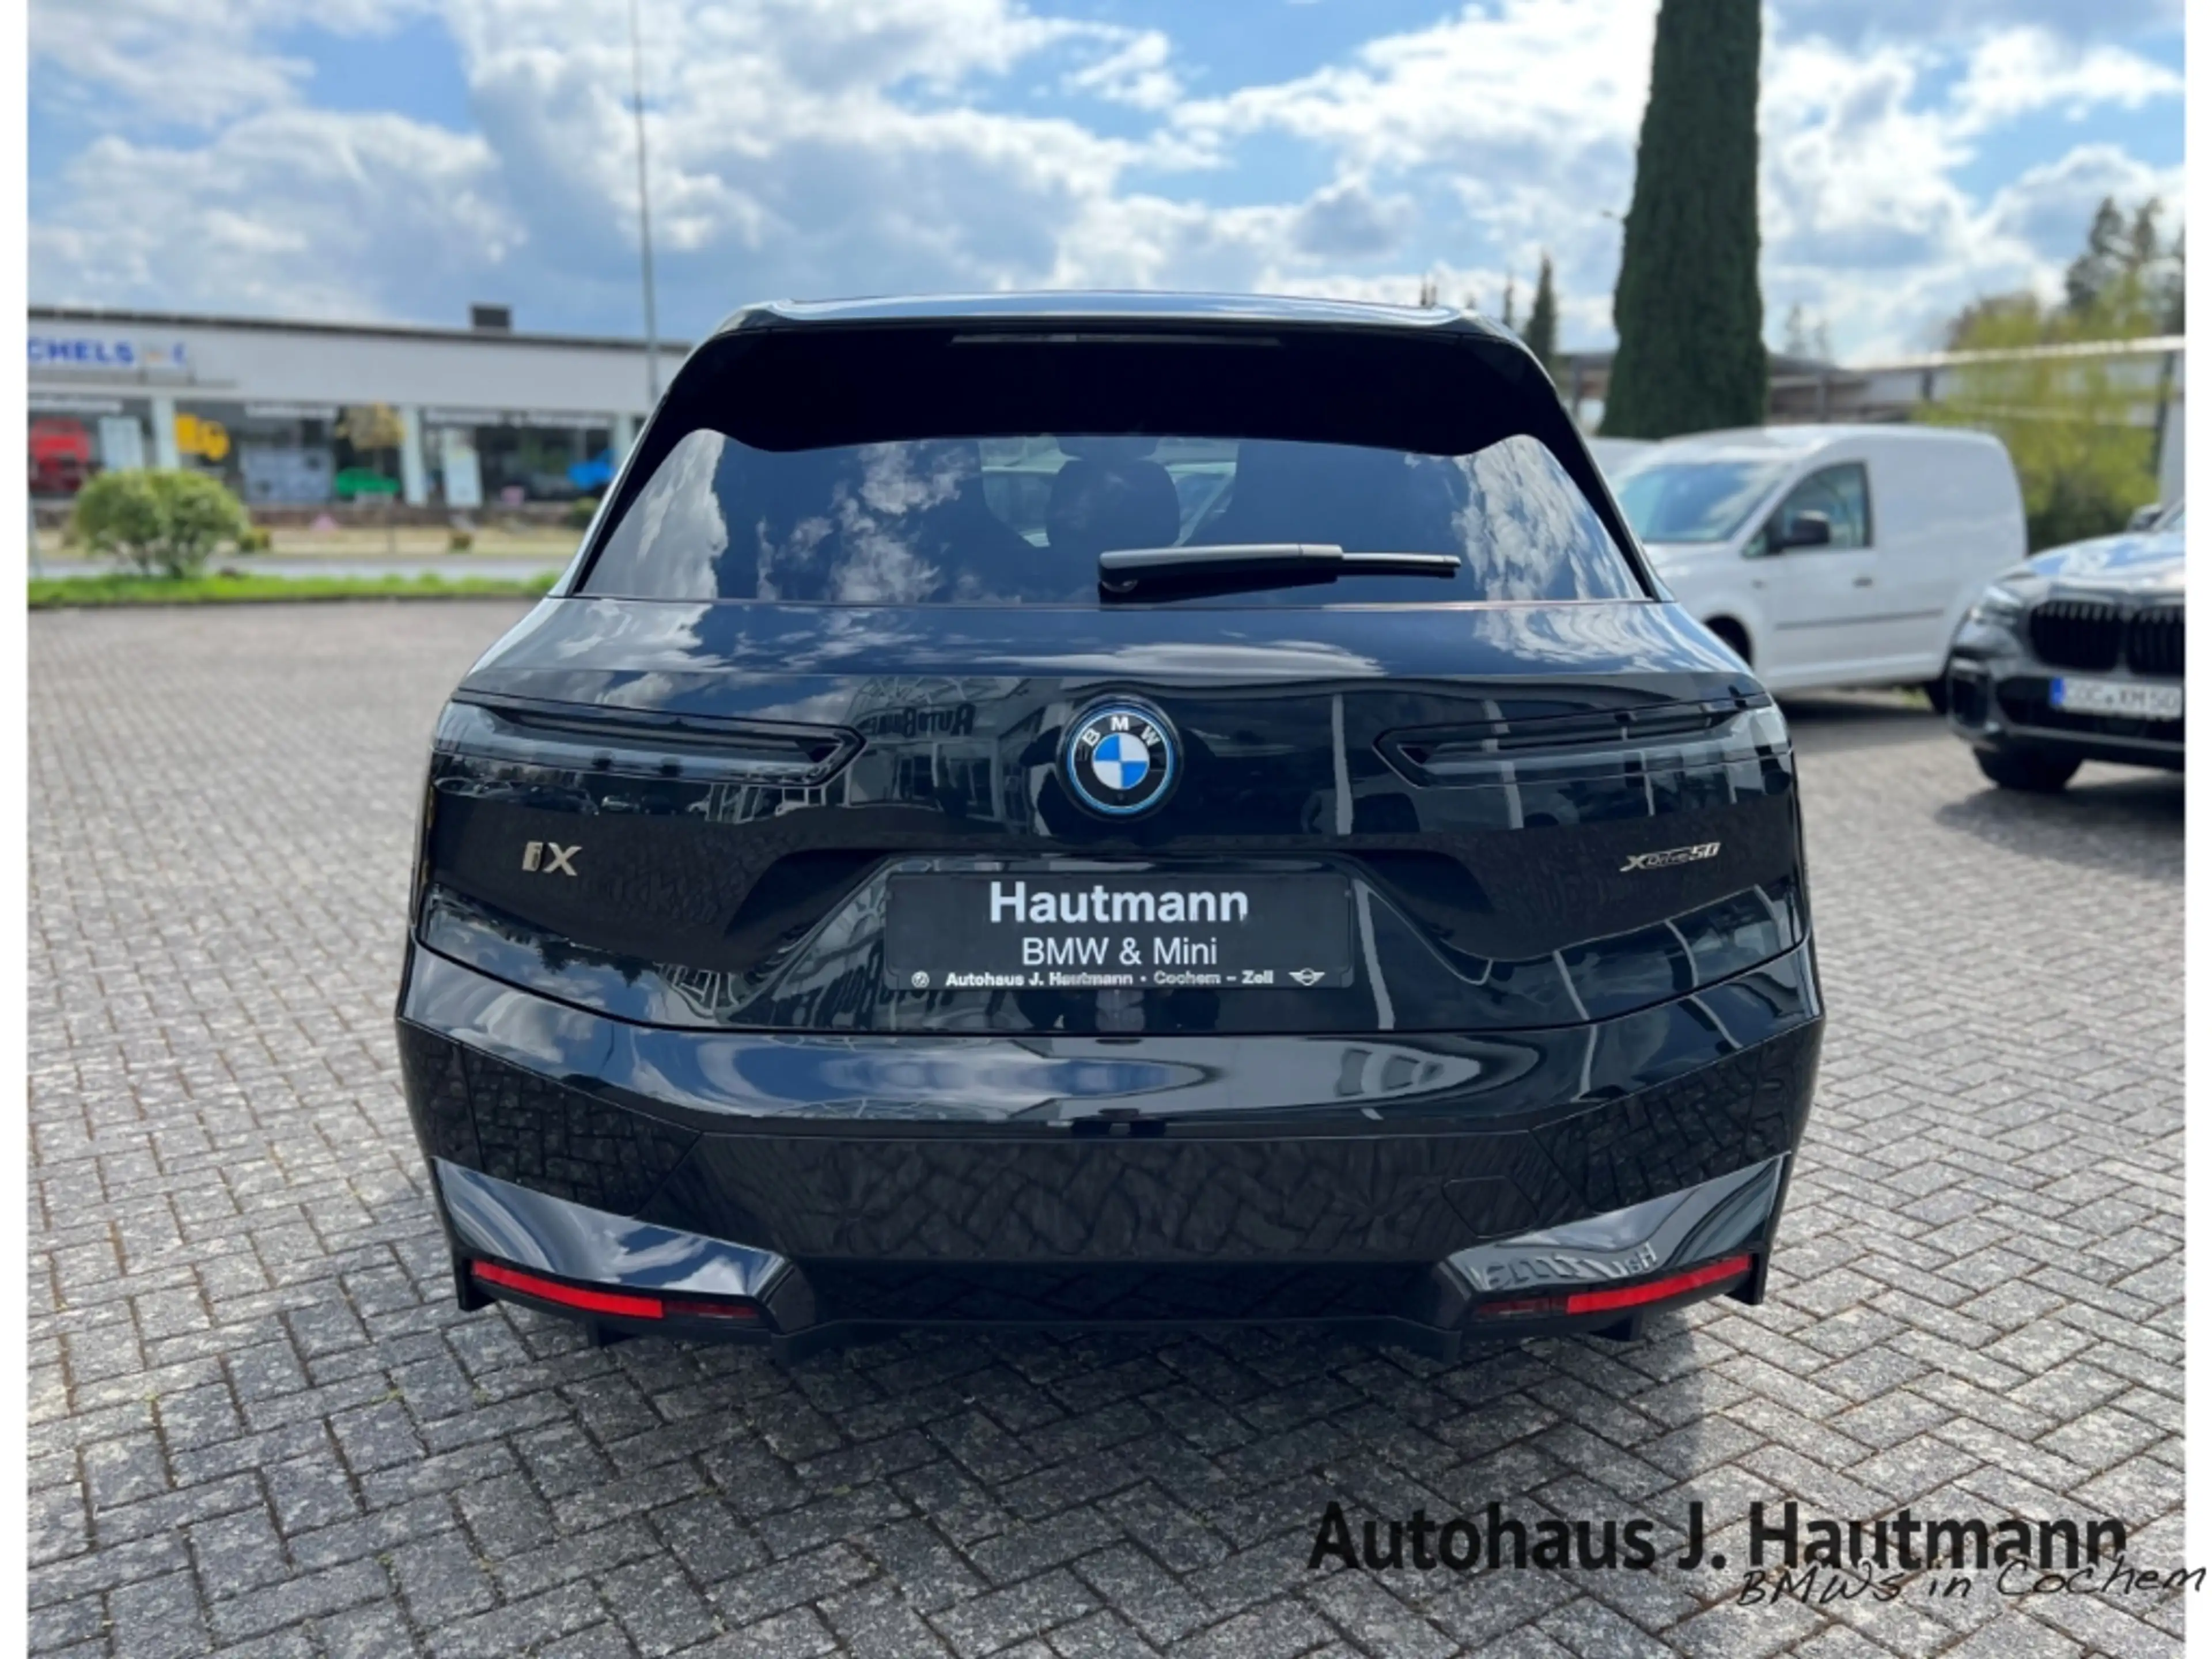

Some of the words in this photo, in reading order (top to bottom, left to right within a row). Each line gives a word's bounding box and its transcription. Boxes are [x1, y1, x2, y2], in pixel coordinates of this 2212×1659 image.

[1081, 715, 1161, 748] BMW
[990, 881, 1249, 922] Hautmann
[1022, 937, 1109, 965] BMW
[1119, 937, 1142, 965] &
[1153, 937, 1217, 965] Mini
[945, 972, 1025, 986] Autohaus
[1028, 972, 1044, 986] J.
[1049, 972, 1133, 986] Hautmann
[1153, 970, 1222, 985] Cochem
[1241, 970, 1274, 984] Zell
